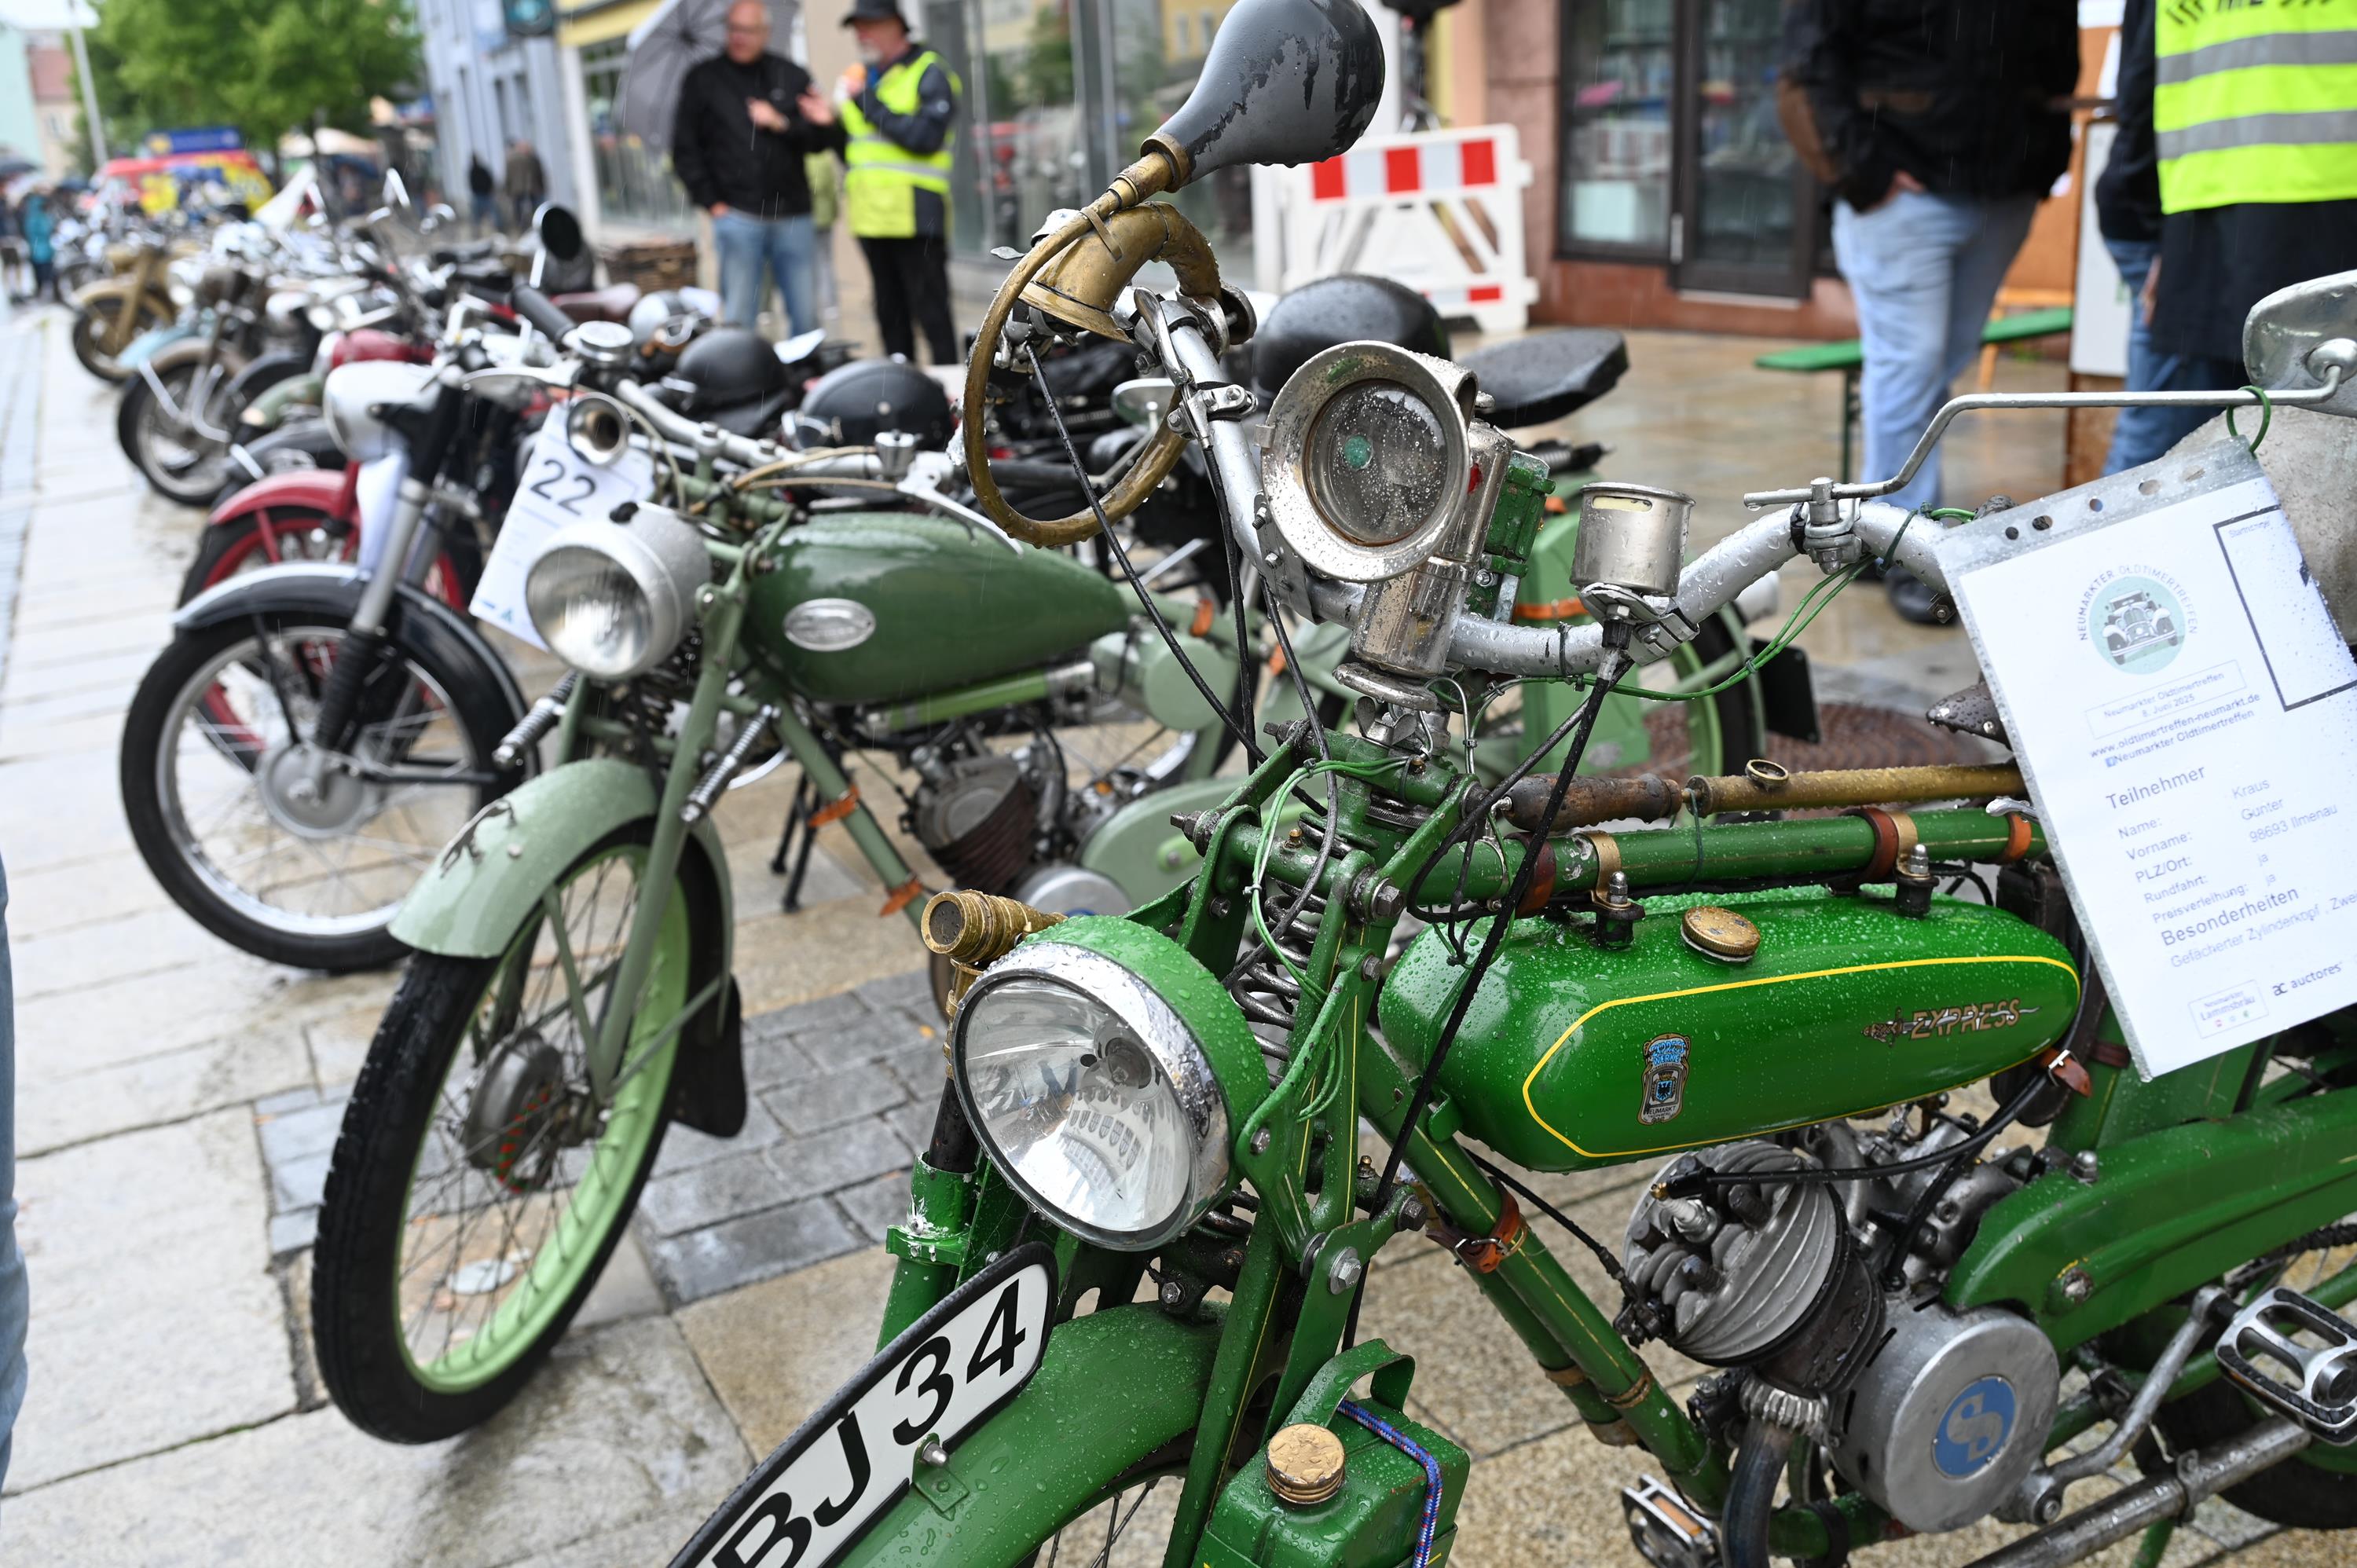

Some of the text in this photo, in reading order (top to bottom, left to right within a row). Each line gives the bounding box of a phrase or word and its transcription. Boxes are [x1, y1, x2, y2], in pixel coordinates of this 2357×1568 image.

[530, 459, 597, 516] 22
[2077, 565, 2198, 641] NEUMARKTER OLDTIMERTREFFEN
[2174, 693, 2195, 708] 2025
[2090, 692, 2261, 757] www.oldtimertreffen-neumarkt.de
[2176, 709, 2255, 742] Oldtimertreffen
[2106, 767, 2205, 810] Teilnehmer
[2118, 779, 2271, 839] Name: Kraus
[2126, 831, 2193, 860] Vorname:
[2135, 804, 2338, 883] PLZ/Ort: 98693 Ilmenau
[2143, 874, 2209, 904] Rundfahrt:
[2152, 883, 2248, 923] Preisverleihung:
[2161, 888, 2299, 947] Besonderheiten
[2247, 903, 2320, 941] Zylinderkopf
[2291, 963, 2342, 989] auctores
[1911, 998, 2021, 1040] EXPRESS
[1652, 1053, 1681, 1066] WERKE
[892, 1278, 1026, 1446] 34
